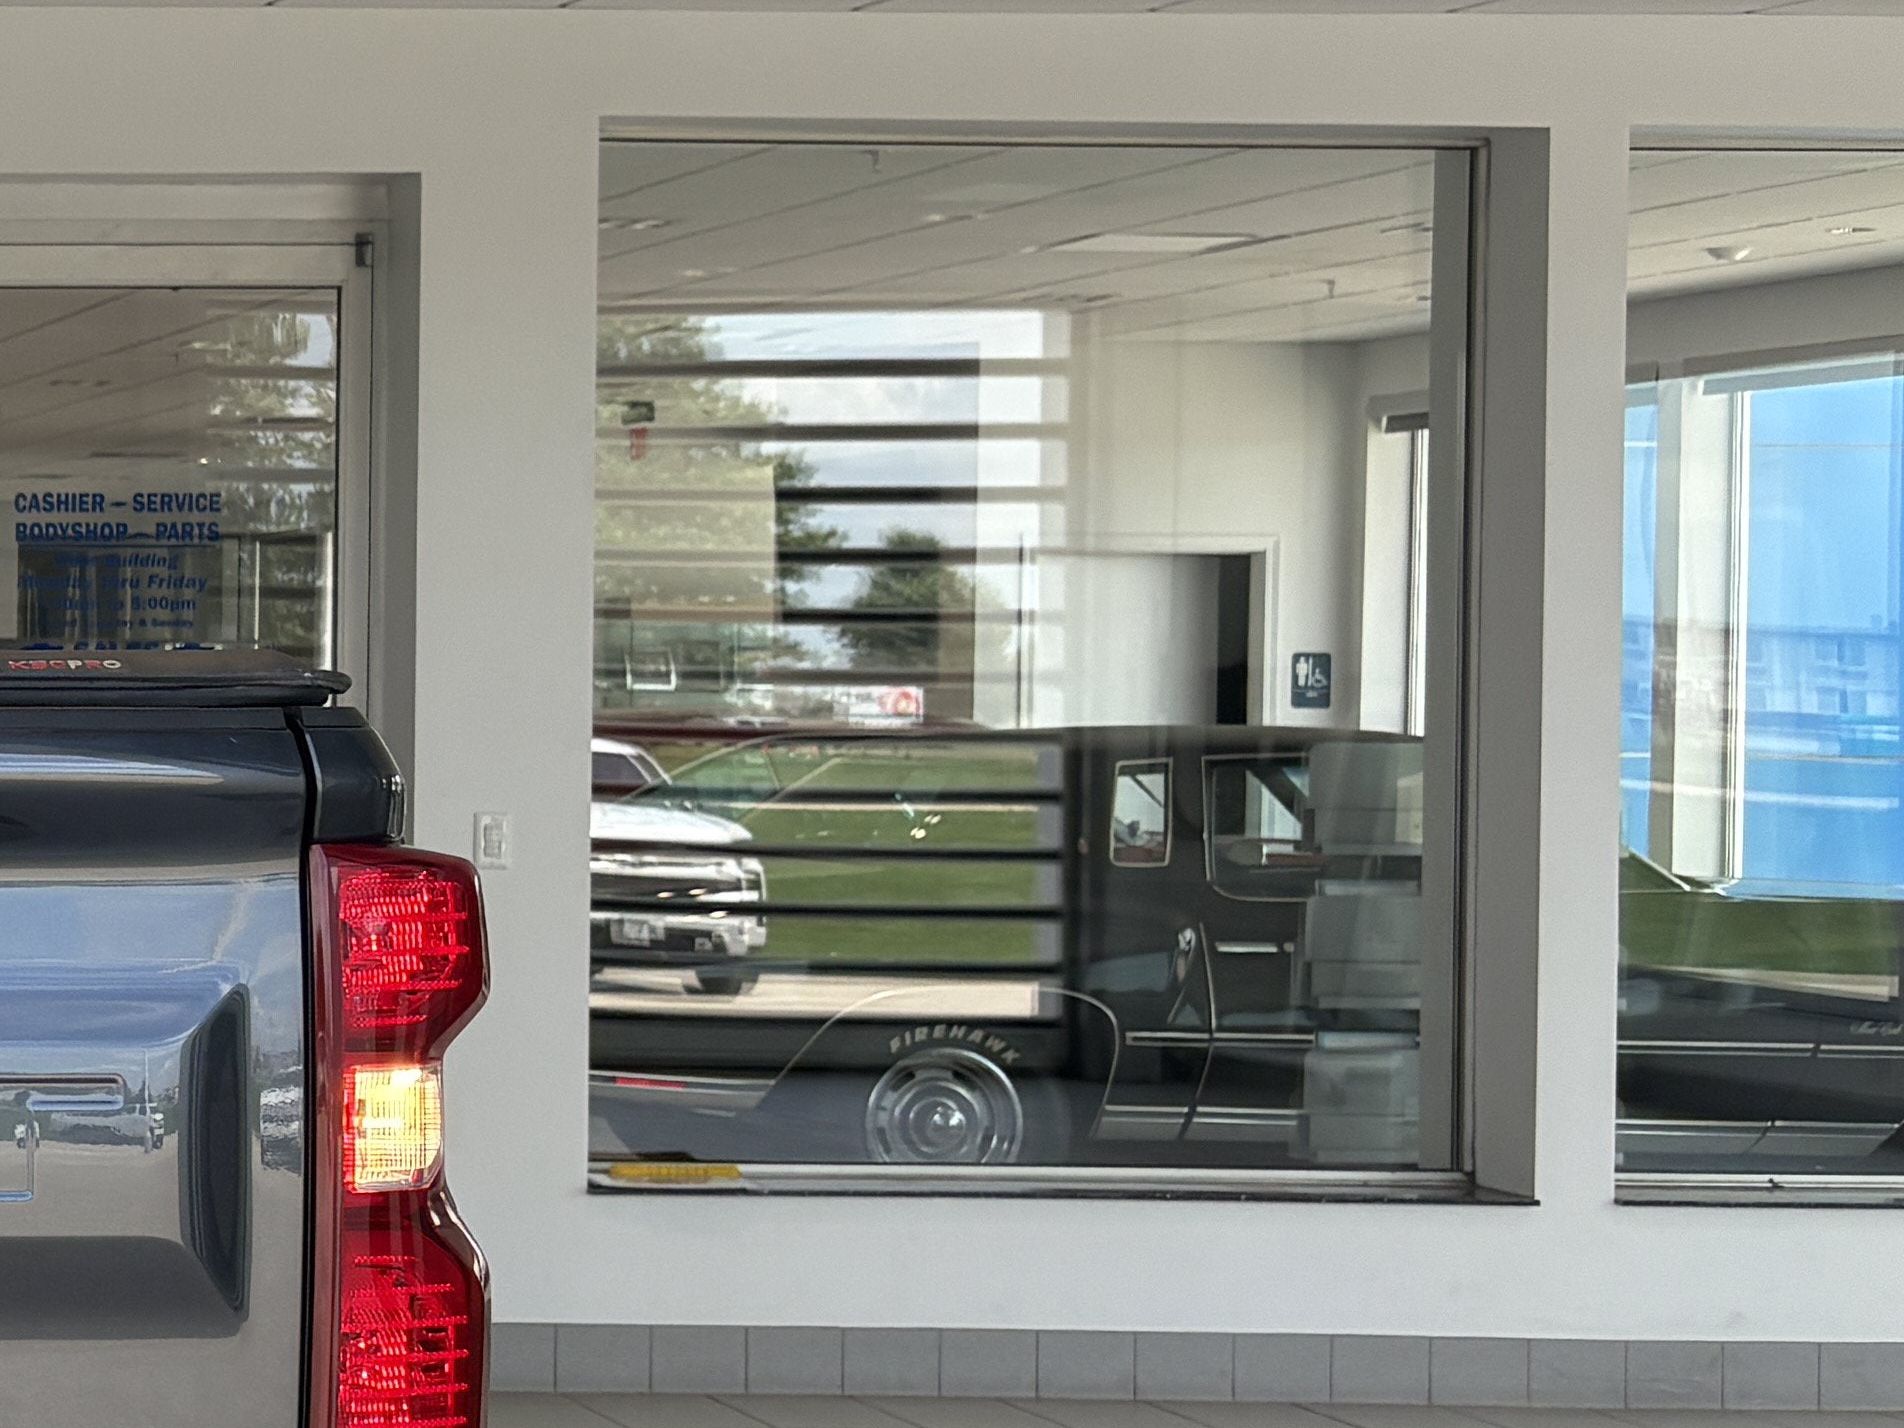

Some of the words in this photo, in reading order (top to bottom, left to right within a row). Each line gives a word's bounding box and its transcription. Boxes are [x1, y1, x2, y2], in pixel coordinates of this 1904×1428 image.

[14, 492, 105, 513] CASHIER
[132, 492, 222, 513] SERVICE
[15, 522, 128, 543] BODYSHOP
[155, 522, 220, 543] PARTS
[148, 574, 207, 592] Friday
[889, 1024, 1021, 1065] FIREHAWK
